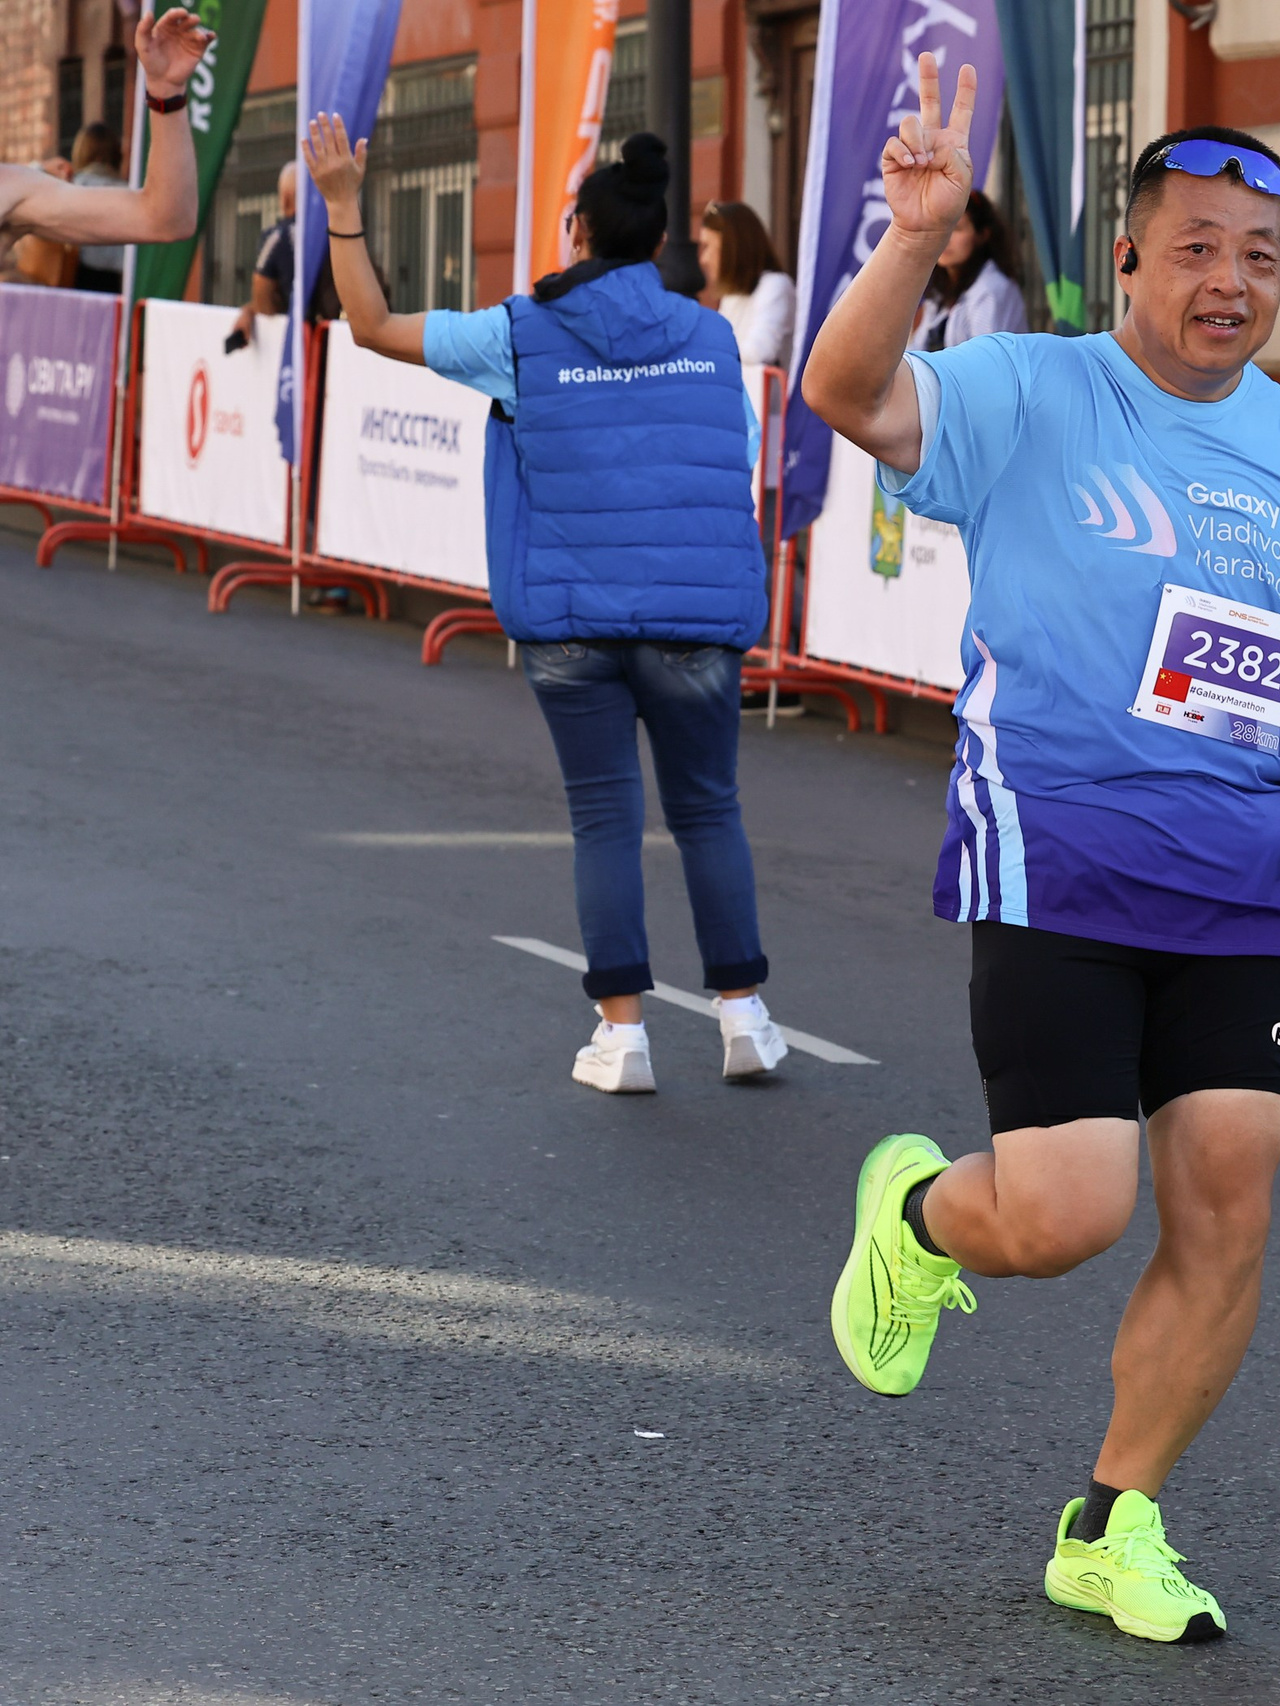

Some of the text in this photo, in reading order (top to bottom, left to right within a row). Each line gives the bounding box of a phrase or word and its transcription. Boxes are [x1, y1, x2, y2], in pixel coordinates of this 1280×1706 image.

[558, 357, 716, 384] #GalaxyMarathon
[1186, 482, 1280, 530] Galaxy
[1229, 609, 1248, 622] DNS
[1189, 685, 1266, 714] #GalaxyMarathon
[1230, 720, 1279, 750] 28km
